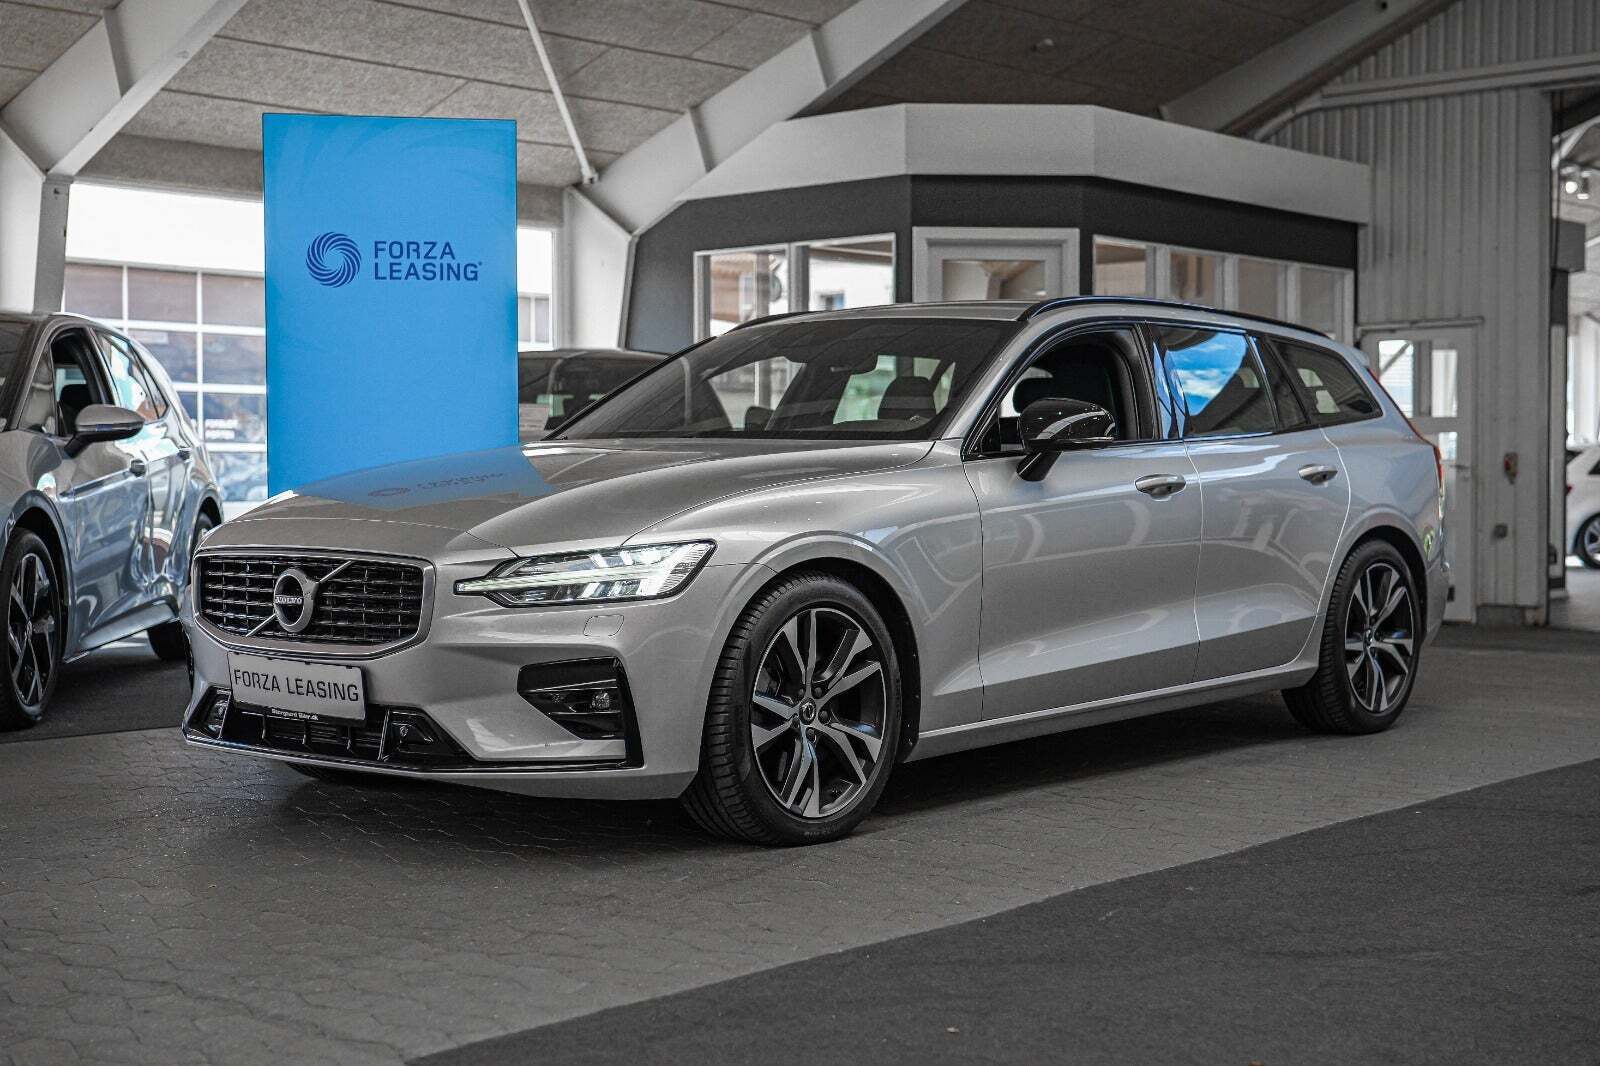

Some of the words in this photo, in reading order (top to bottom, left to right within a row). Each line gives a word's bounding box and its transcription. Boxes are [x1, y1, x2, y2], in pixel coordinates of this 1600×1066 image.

[374, 241, 456, 260] FORZA
[374, 262, 479, 281] LEASING
[275, 596, 302, 604] VOLVO
[234, 669, 281, 692] FORZA
[286, 676, 359, 701] LEASING
